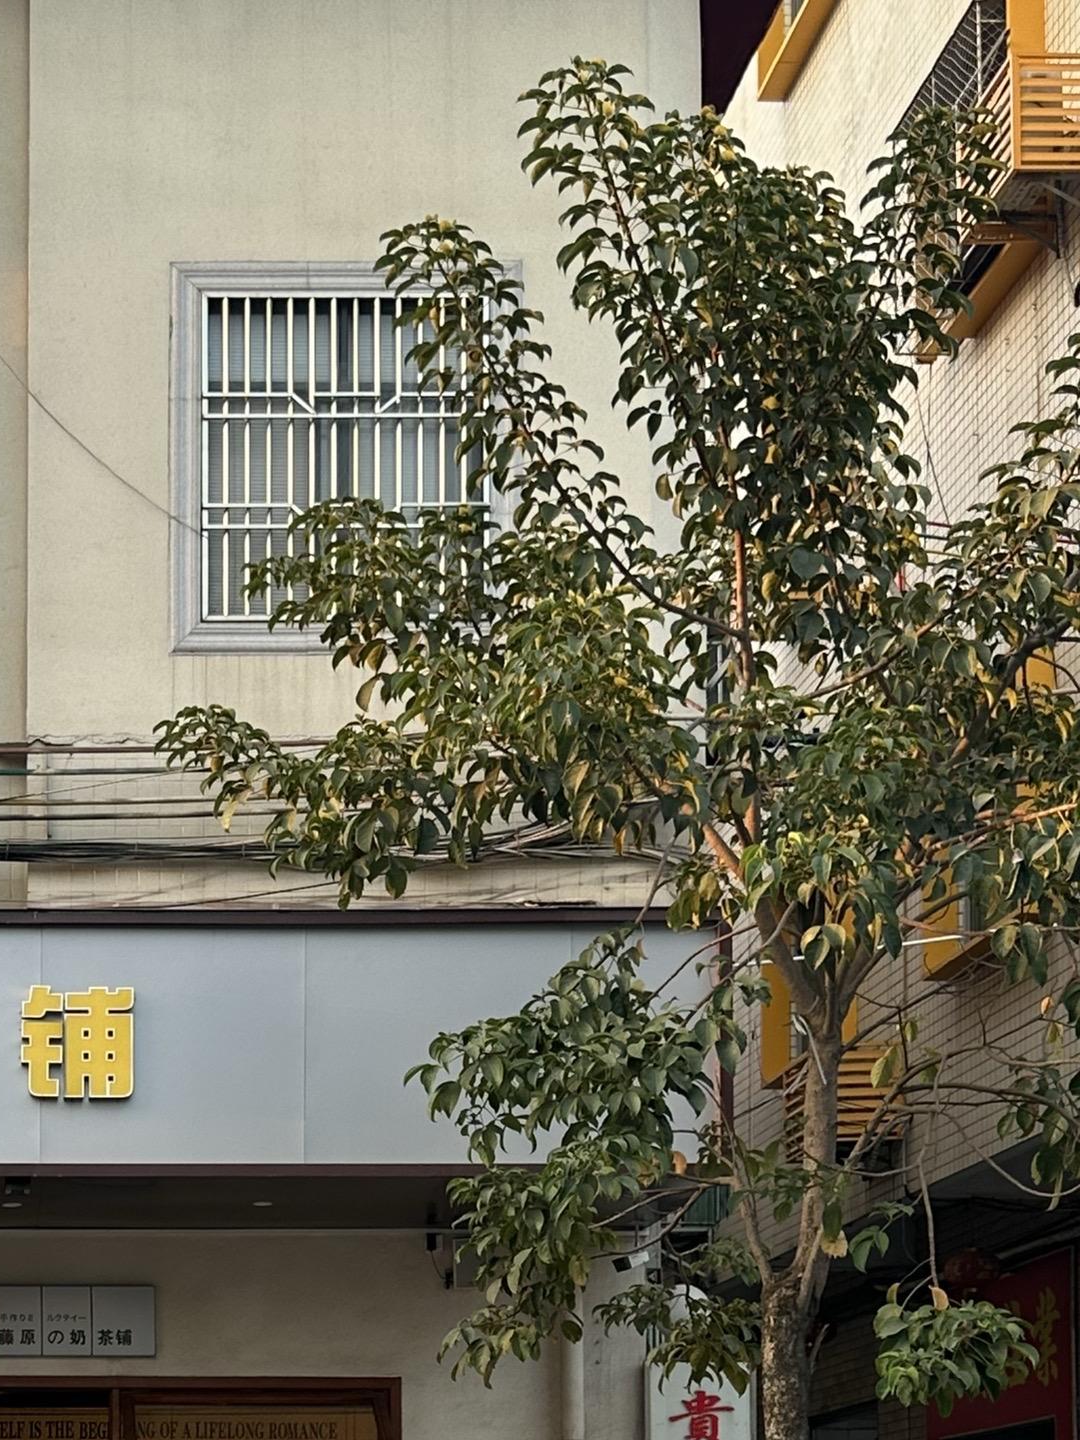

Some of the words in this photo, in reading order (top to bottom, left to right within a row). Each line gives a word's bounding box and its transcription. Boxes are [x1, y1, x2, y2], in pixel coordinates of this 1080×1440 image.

[29, 1419, 42, 1439] IS
[45, 1419, 74, 1439] THE
[159, 1421, 178, 1439] OF
[183, 1421, 192, 1439] A
[195, 1421, 264, 1440] LIFELONG
[269, 1422, 338, 1440] ROMANCE
